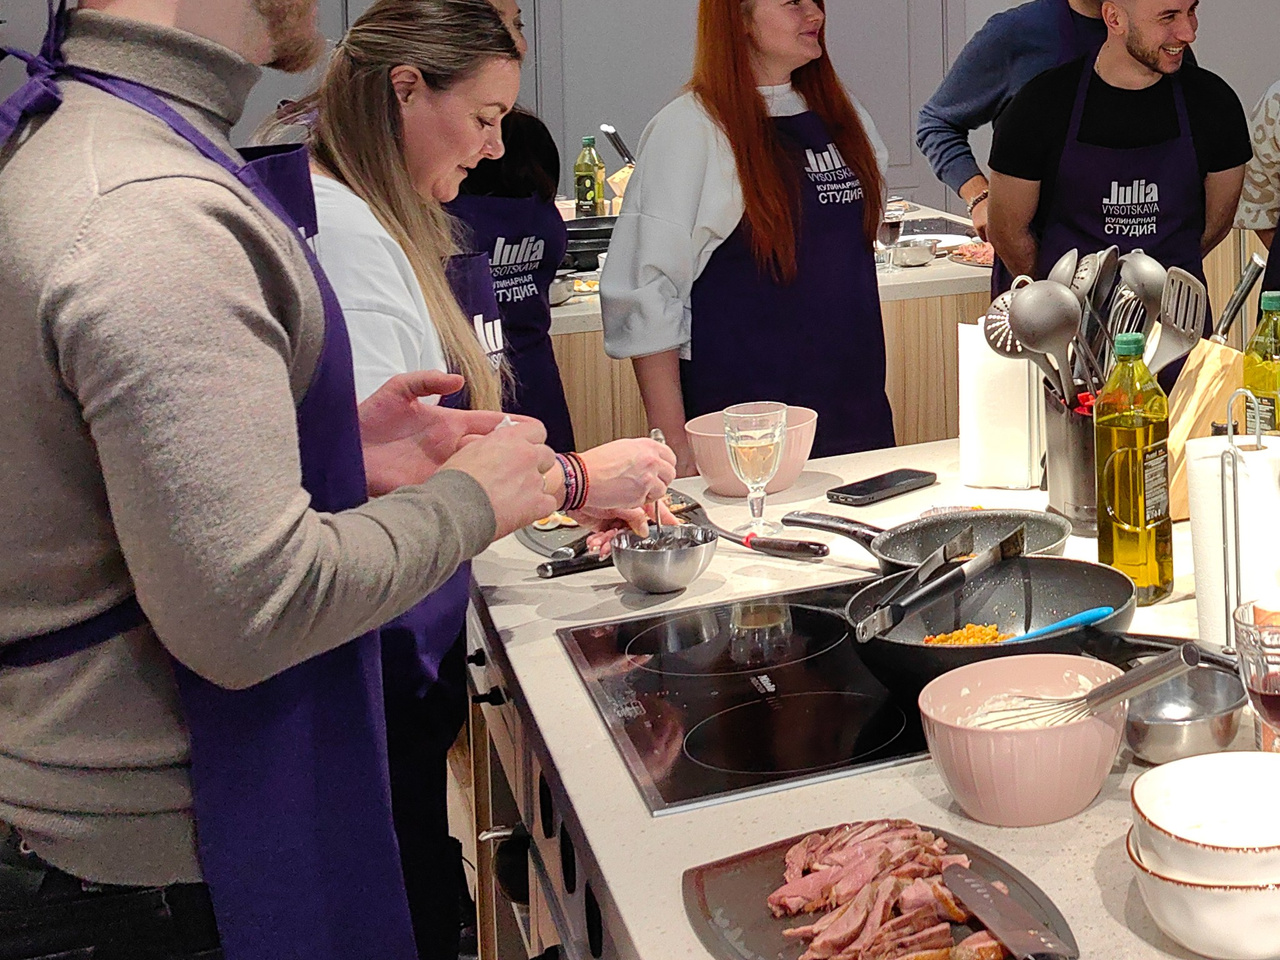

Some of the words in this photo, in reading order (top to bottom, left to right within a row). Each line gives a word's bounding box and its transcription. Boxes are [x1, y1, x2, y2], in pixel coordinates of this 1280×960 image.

[818, 188, 864, 204] СТУДИЯ
[1102, 179, 1159, 205] Julia
[1102, 203, 1160, 215] VYSOTSKAYA
[1105, 216, 1157, 225] КУЛИНАРНАЯ
[1104, 223, 1157, 237] СТУДИЯ
[489, 236, 545, 266] Julia
[489, 261, 540, 277] YSOTSKAYA
[494, 283, 539, 303] ТУДИЯ
